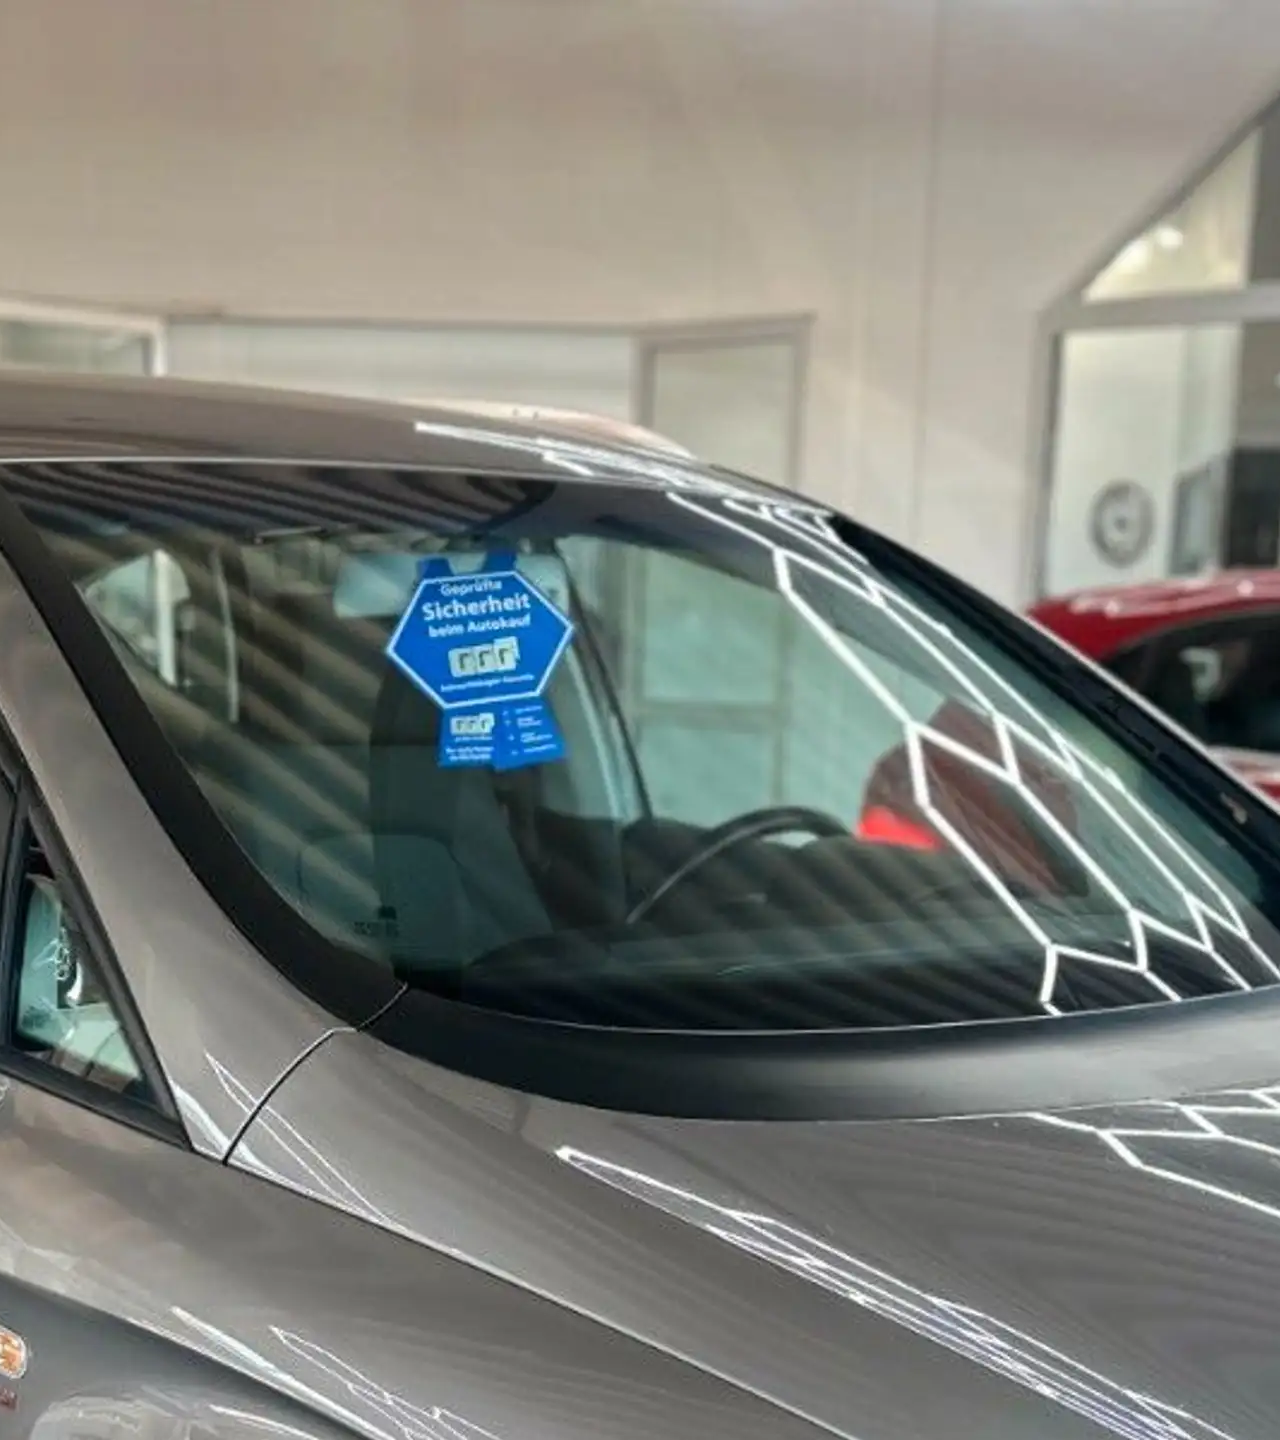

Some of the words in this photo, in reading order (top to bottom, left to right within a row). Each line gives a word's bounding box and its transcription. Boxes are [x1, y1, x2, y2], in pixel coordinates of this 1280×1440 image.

[422, 592, 531, 622] Sicherheit
[428, 623, 464, 638] beim
[467, 614, 531, 634] Autokauf
